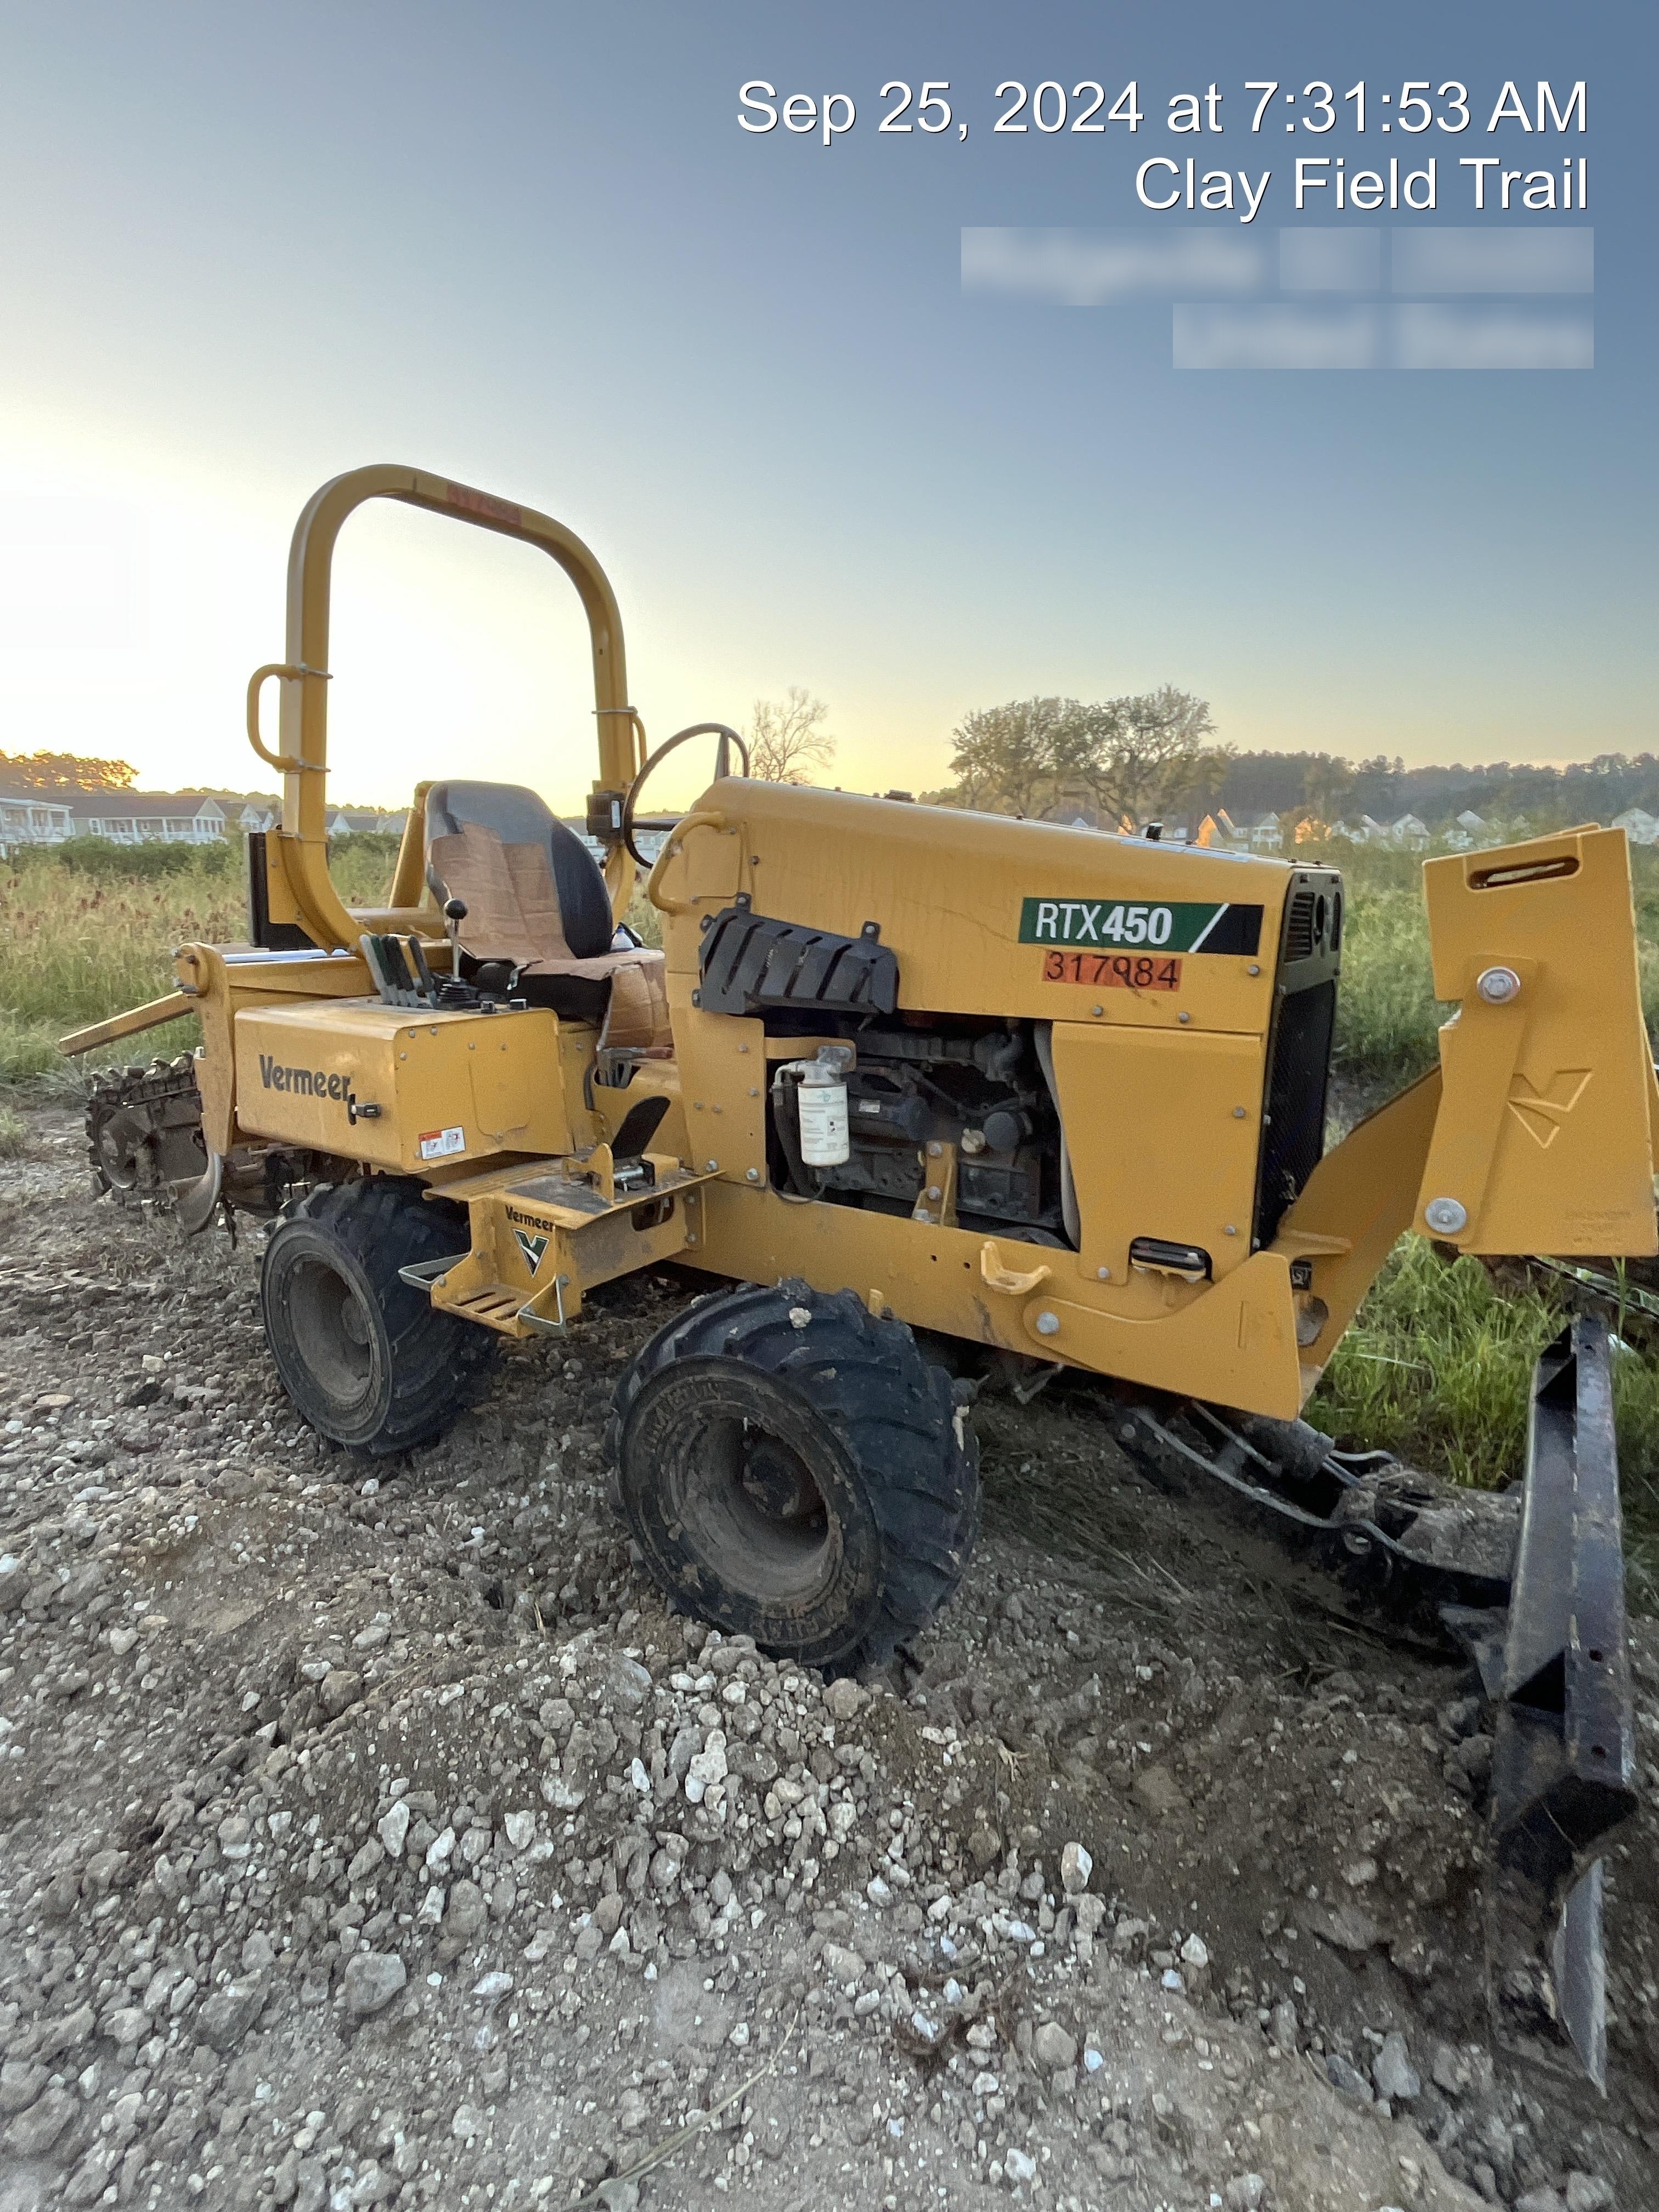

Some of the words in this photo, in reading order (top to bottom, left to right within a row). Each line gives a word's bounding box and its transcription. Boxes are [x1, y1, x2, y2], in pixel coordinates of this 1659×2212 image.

[1036, 902, 1173, 945] RTX450
[1047, 951, 1177, 989] 317984
[259, 1054, 351, 1102] Vermeer
[505, 1204, 554, 1232] Vermeer
